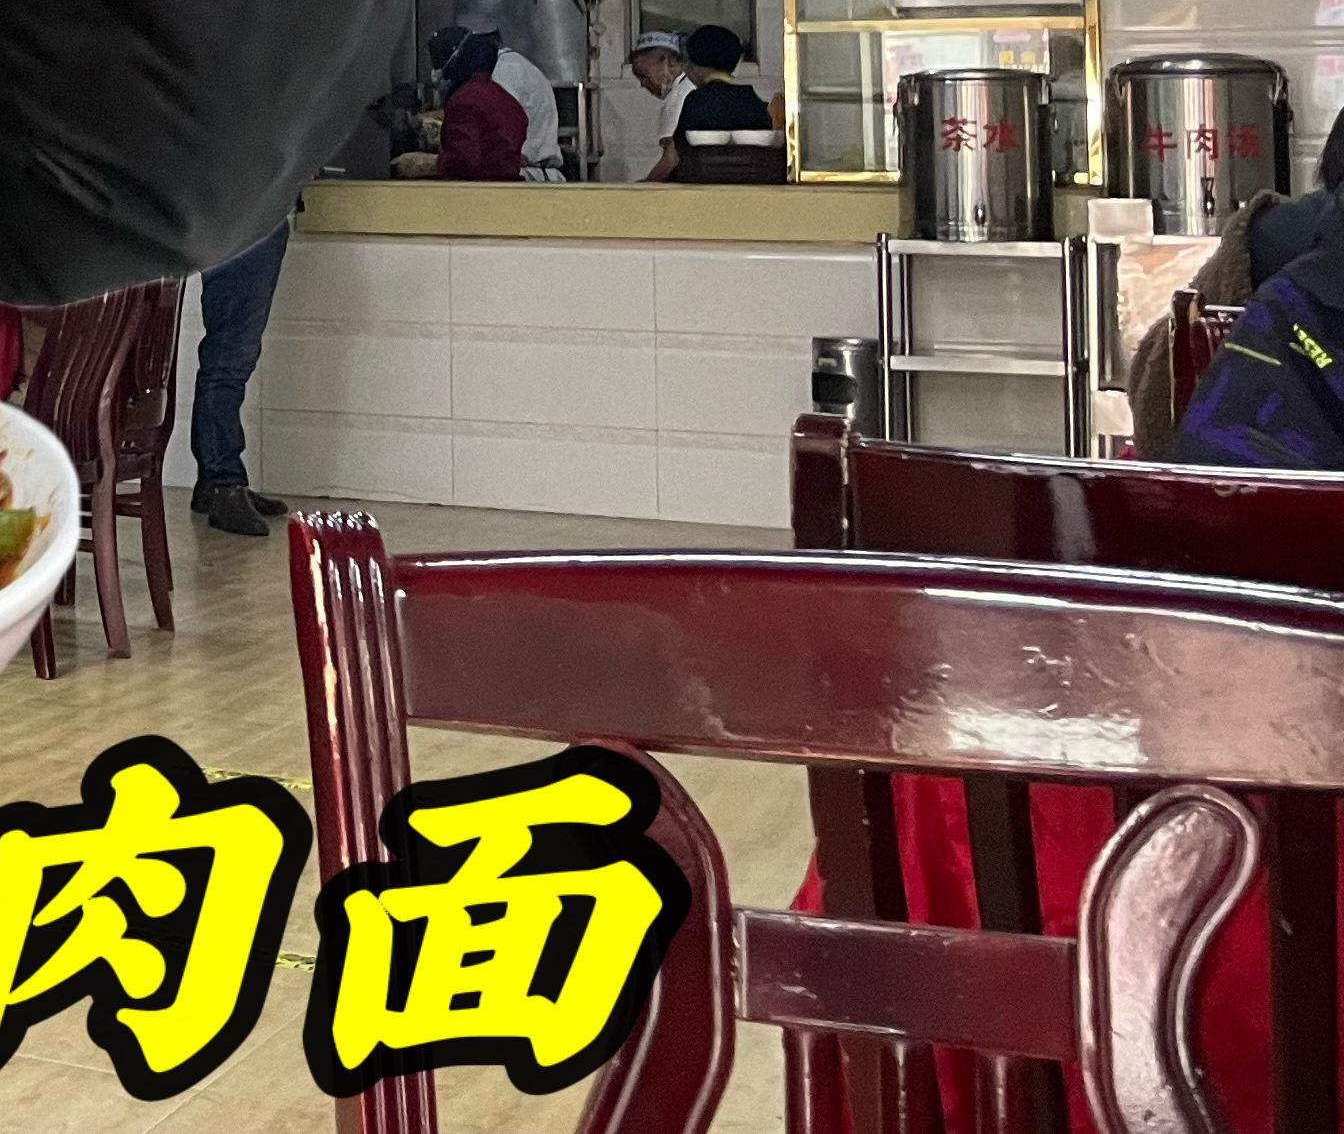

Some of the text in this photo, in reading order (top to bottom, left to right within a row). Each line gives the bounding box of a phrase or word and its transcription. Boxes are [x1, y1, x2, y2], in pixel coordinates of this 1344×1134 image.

[941, 117, 1020, 153] 茶水
[1144, 123, 1263, 163] 牛肉汤
